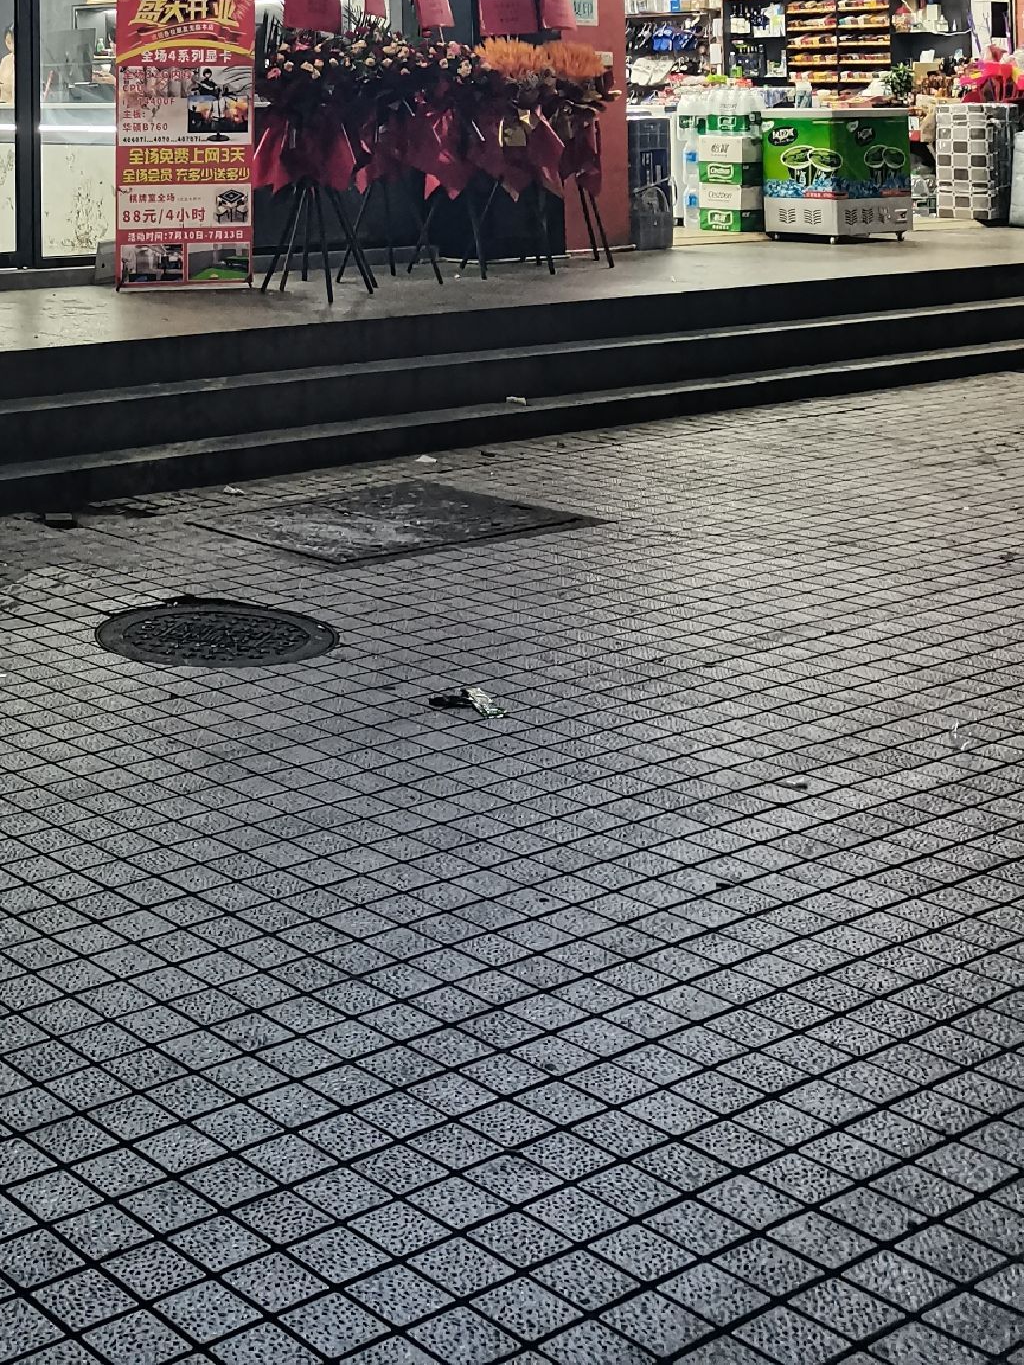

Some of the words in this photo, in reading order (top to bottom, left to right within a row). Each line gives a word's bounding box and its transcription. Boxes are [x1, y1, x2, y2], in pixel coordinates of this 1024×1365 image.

[141, 49, 232, 63] 全场4系列显卡
[129, 147, 246, 165] 全场免费上网3天
[123, 168, 172, 183] 全场会员
[122, 207, 206, 224] 88元/4小时
